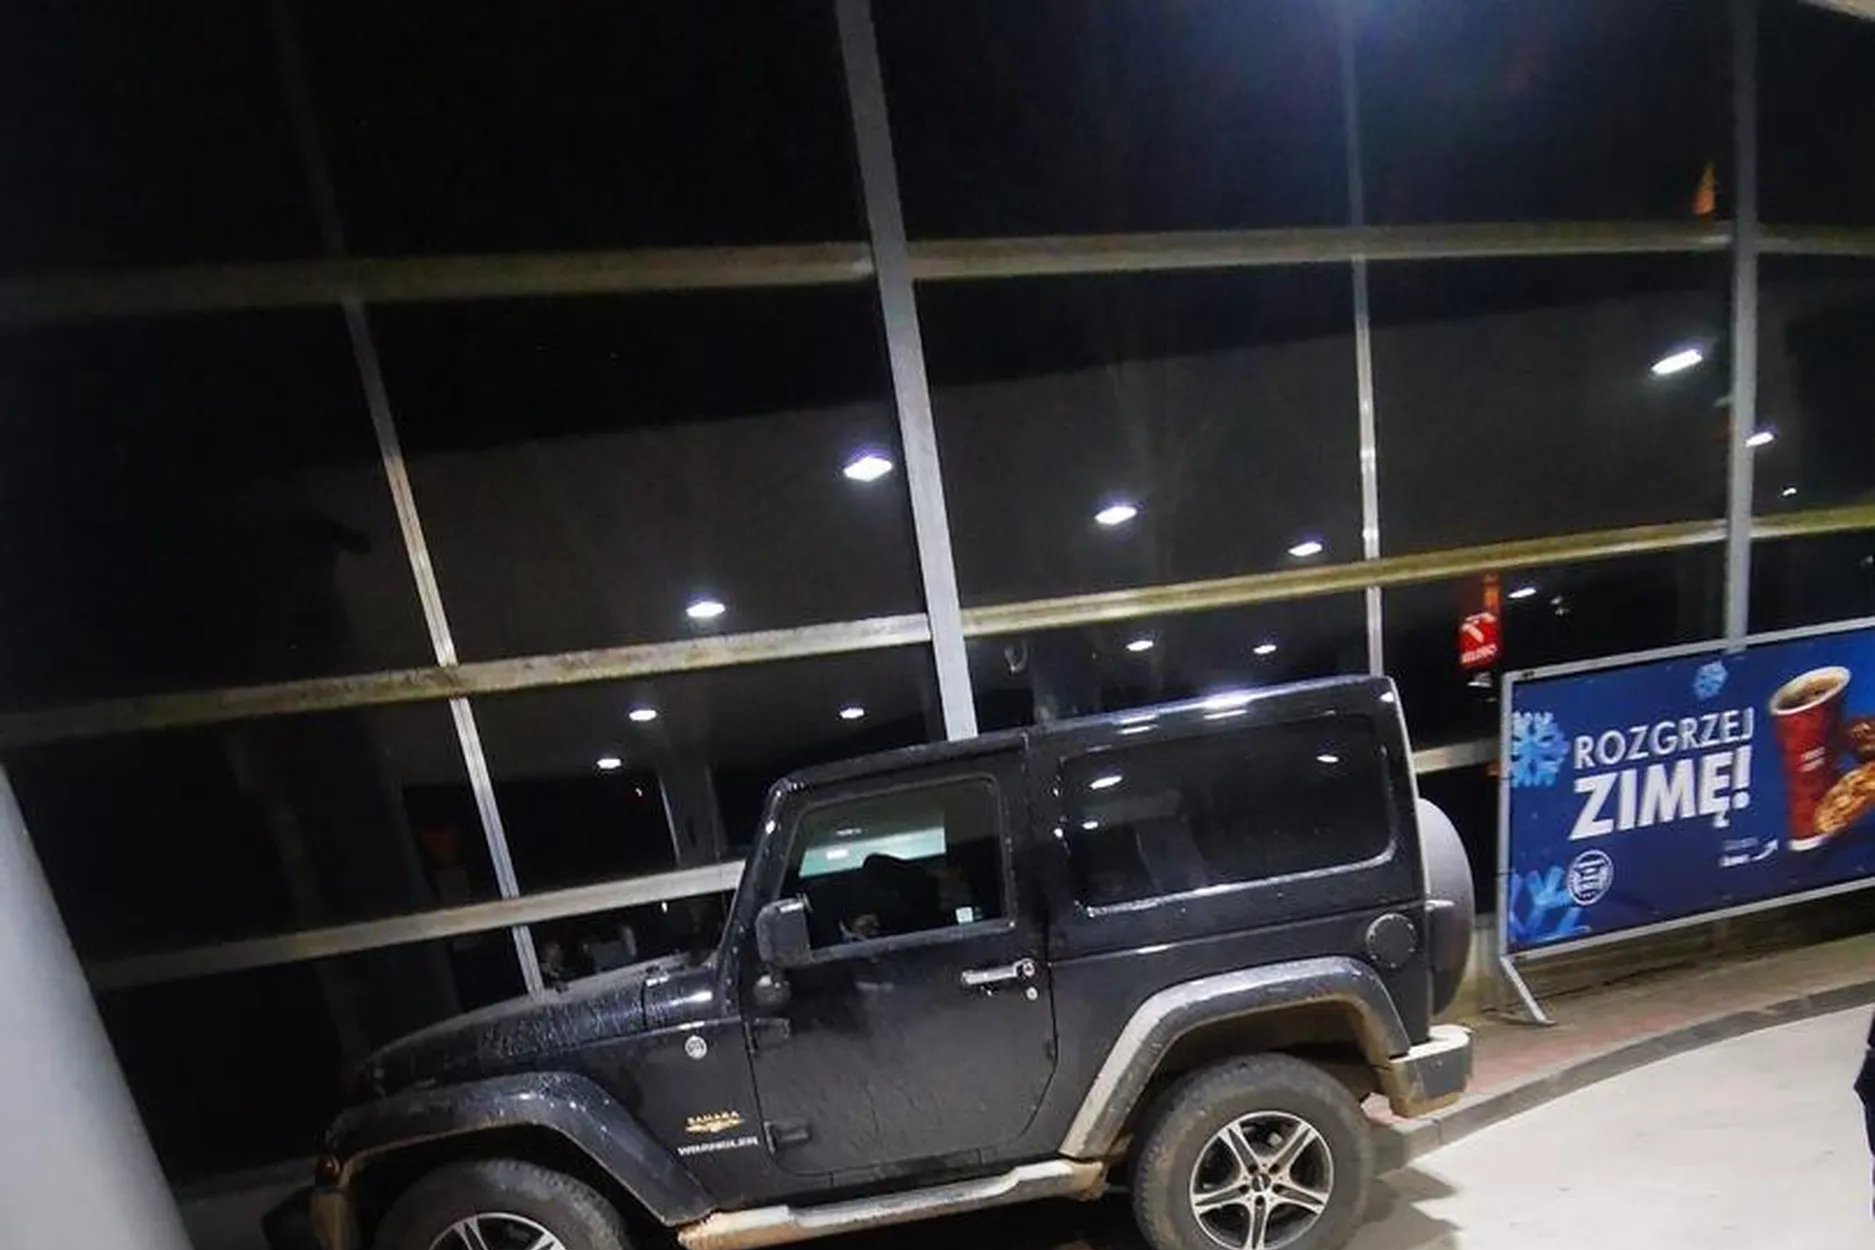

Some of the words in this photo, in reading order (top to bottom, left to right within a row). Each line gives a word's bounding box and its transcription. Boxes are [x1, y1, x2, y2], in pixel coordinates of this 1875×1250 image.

[1574, 706, 1755, 770] ROZGRZEJ
[1568, 745, 1752, 841] ZIMĘ!
[677, 1136, 759, 1156] WRANGLER
